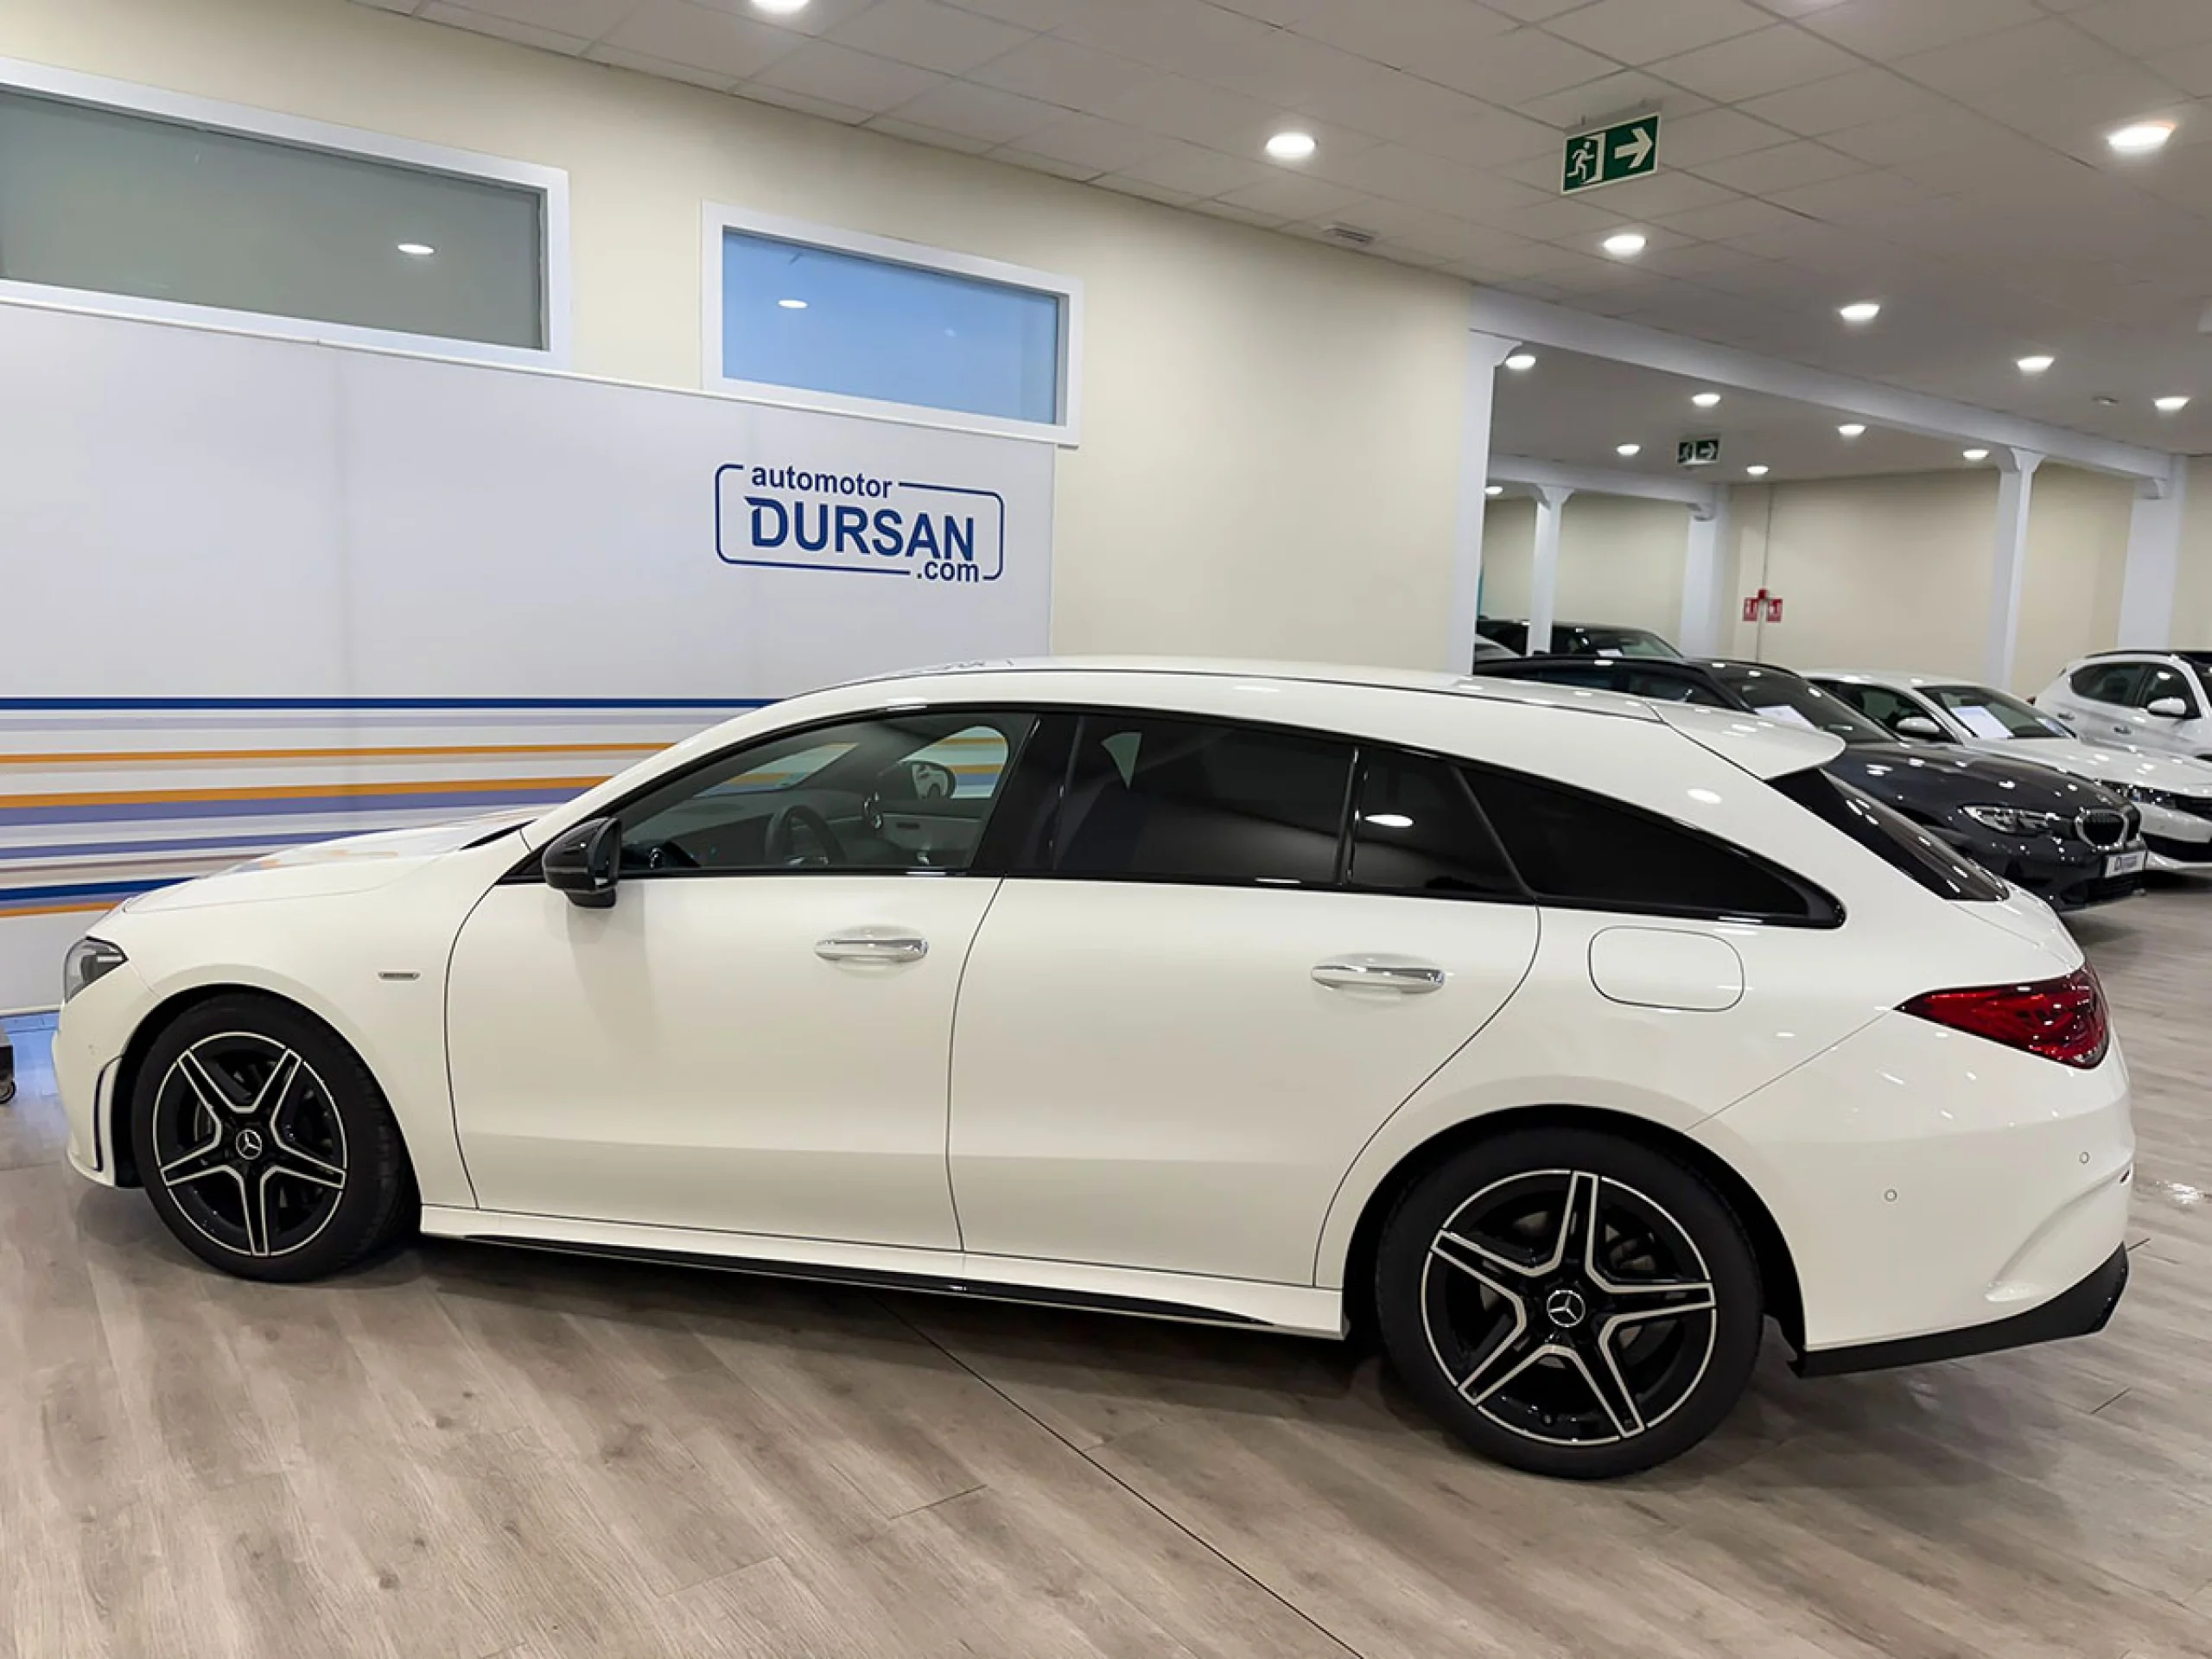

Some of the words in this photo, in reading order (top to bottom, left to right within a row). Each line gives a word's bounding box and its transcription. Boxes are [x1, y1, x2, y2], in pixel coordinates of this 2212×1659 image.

[751, 466, 893, 498] automotor
[744, 496, 975, 561] DURSAN
[916, 561, 980, 582] .com
